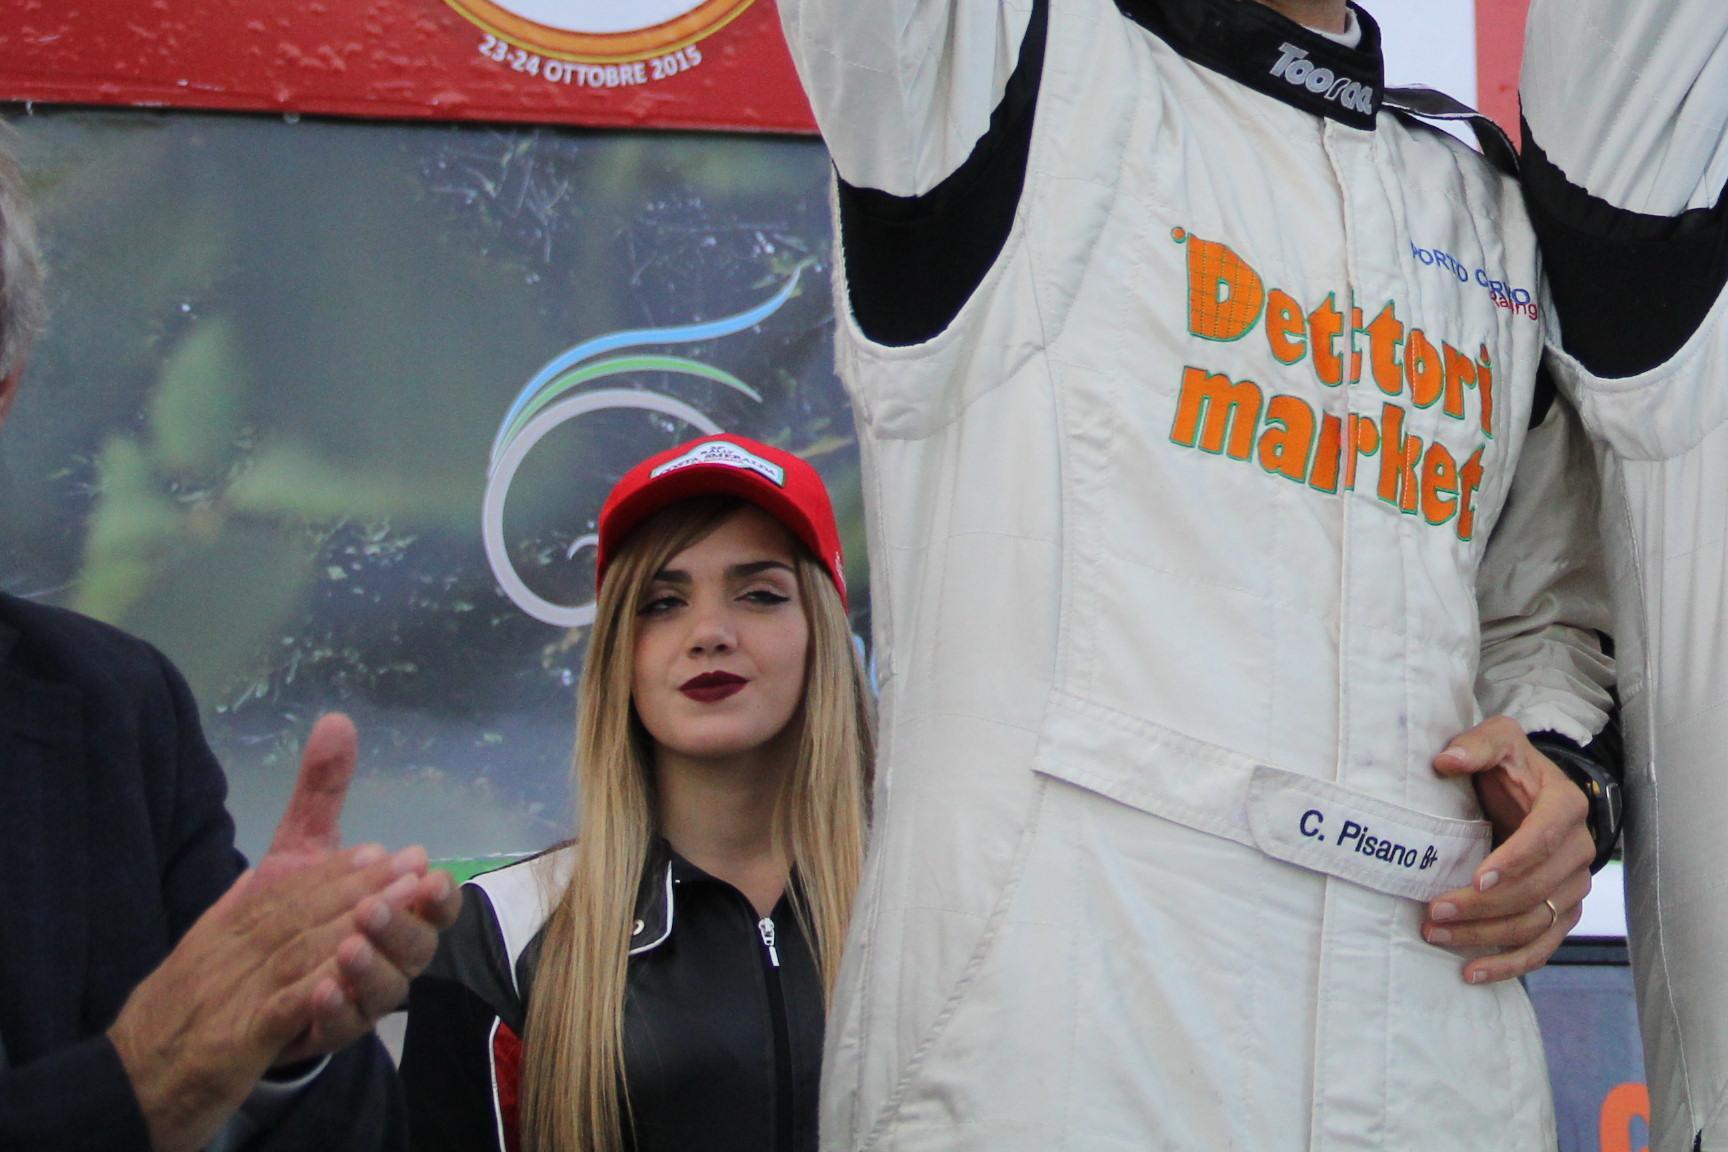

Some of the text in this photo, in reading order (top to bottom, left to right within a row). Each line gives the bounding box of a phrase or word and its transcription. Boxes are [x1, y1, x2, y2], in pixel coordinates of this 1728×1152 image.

[478, 33, 703, 88] 23-24 OTTOBRE 2015
[1410, 241, 1469, 282] PORTO
[1185, 232, 1493, 439] Dettori
[1169, 364, 1486, 542] market
[1299, 808, 1326, 842] C.
[1336, 820, 1418, 869] Pisano
